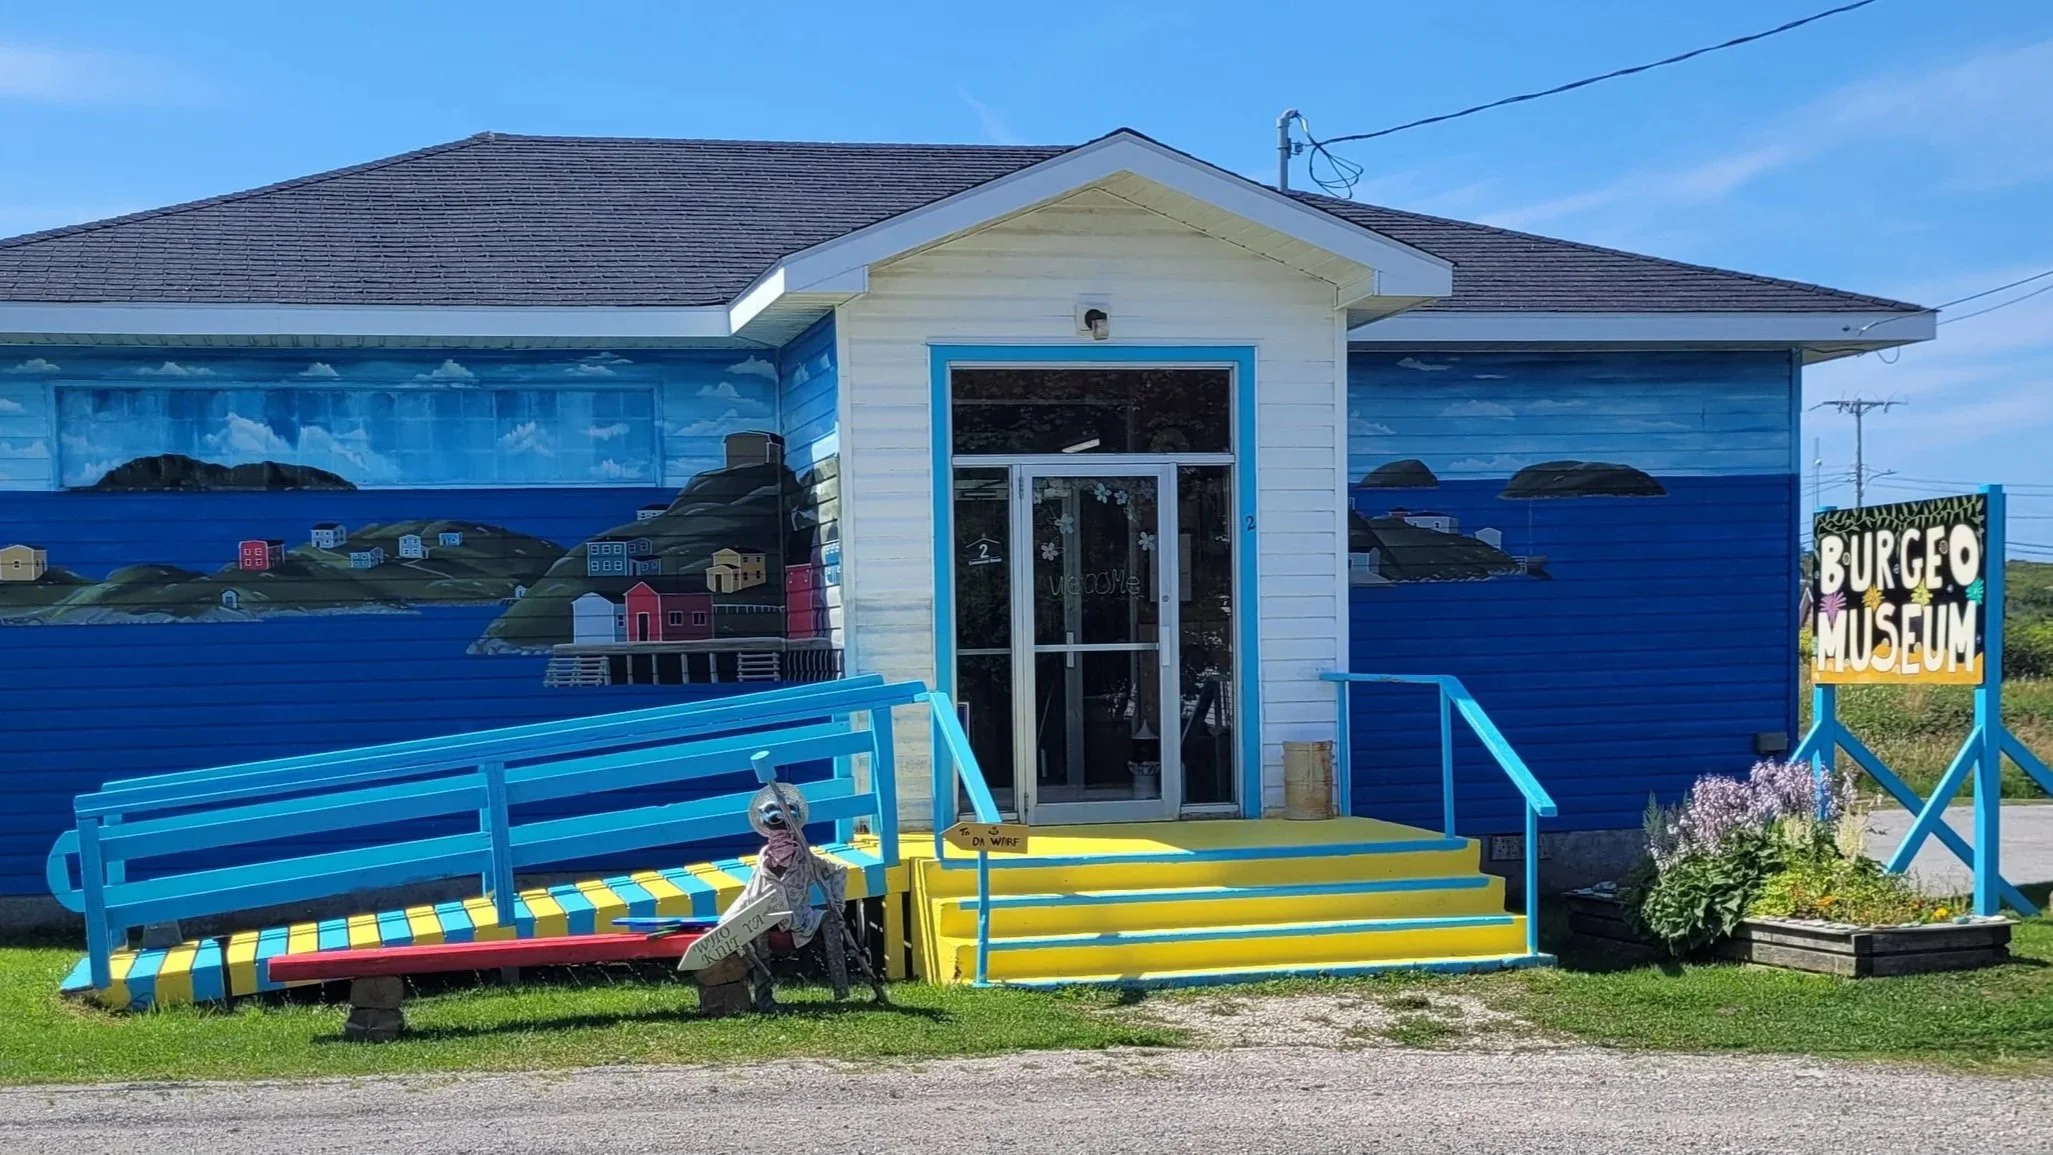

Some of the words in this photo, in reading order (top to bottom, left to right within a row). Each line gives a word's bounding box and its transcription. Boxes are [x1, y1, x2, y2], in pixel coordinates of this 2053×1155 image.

[1245, 515, 1256, 531] 2
[979, 544, 990, 558] 2
[1820, 524, 1979, 595] BURGEO
[1817, 602, 1976, 674] MUSEUM
[972, 836, 985, 847] DA
[742, 914, 765, 933] YA
[693, 925, 731, 954] WHO
